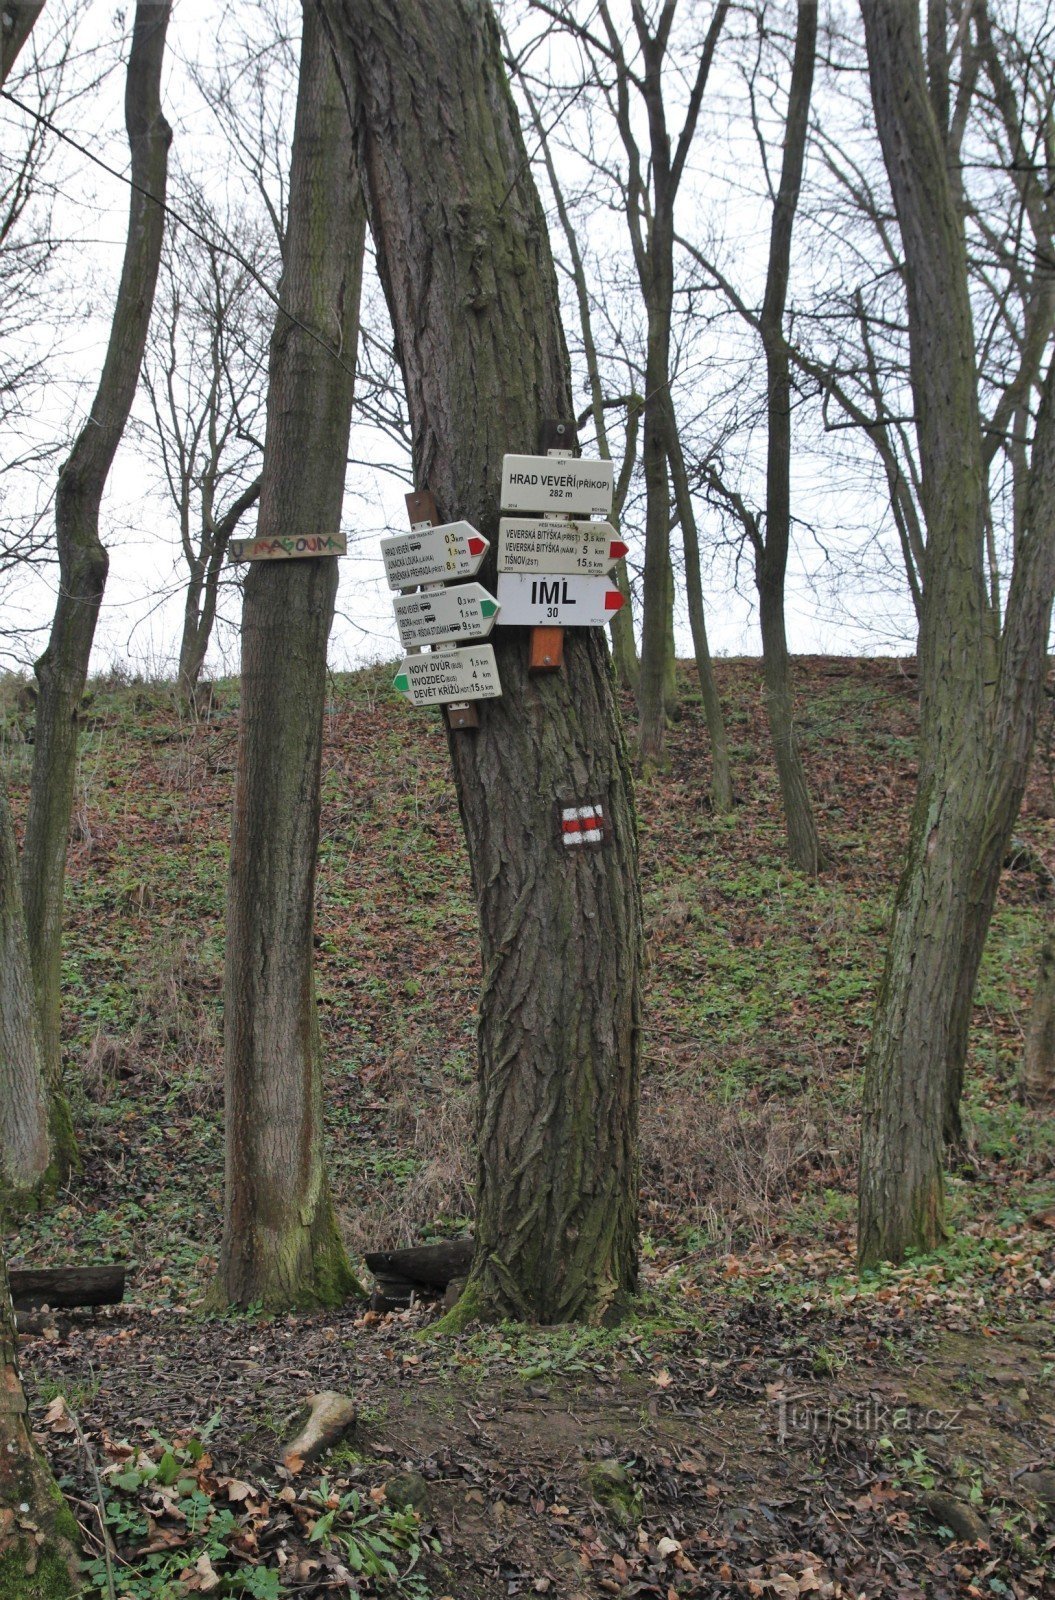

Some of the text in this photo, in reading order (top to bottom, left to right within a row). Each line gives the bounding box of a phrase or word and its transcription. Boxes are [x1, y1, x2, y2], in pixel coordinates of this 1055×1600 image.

[509, 473, 610, 491] HRAD VEVEŘÍ (PŘÍKOP)
[549, 489, 564, 498] 282
[505, 528, 536, 540] VEVERSKÁ
[537, 528, 561, 541] BITÝŠKA
[231, 541, 244, 558] U
[505, 541, 535, 553] VEVERSKÁ
[536, 542, 560, 554] BITÝŠKA
[582, 545, 588, 555] 5
[504, 553, 527, 566] TIŠNOV
[531, 581, 577, 605] IML
[546, 607, 559, 618] 30
[409, 662, 429, 675] NOVÝ
[472, 670, 477, 679] 4
[411, 675, 446, 687] HVOZDEC
[413, 688, 437, 699] DEVĚT
